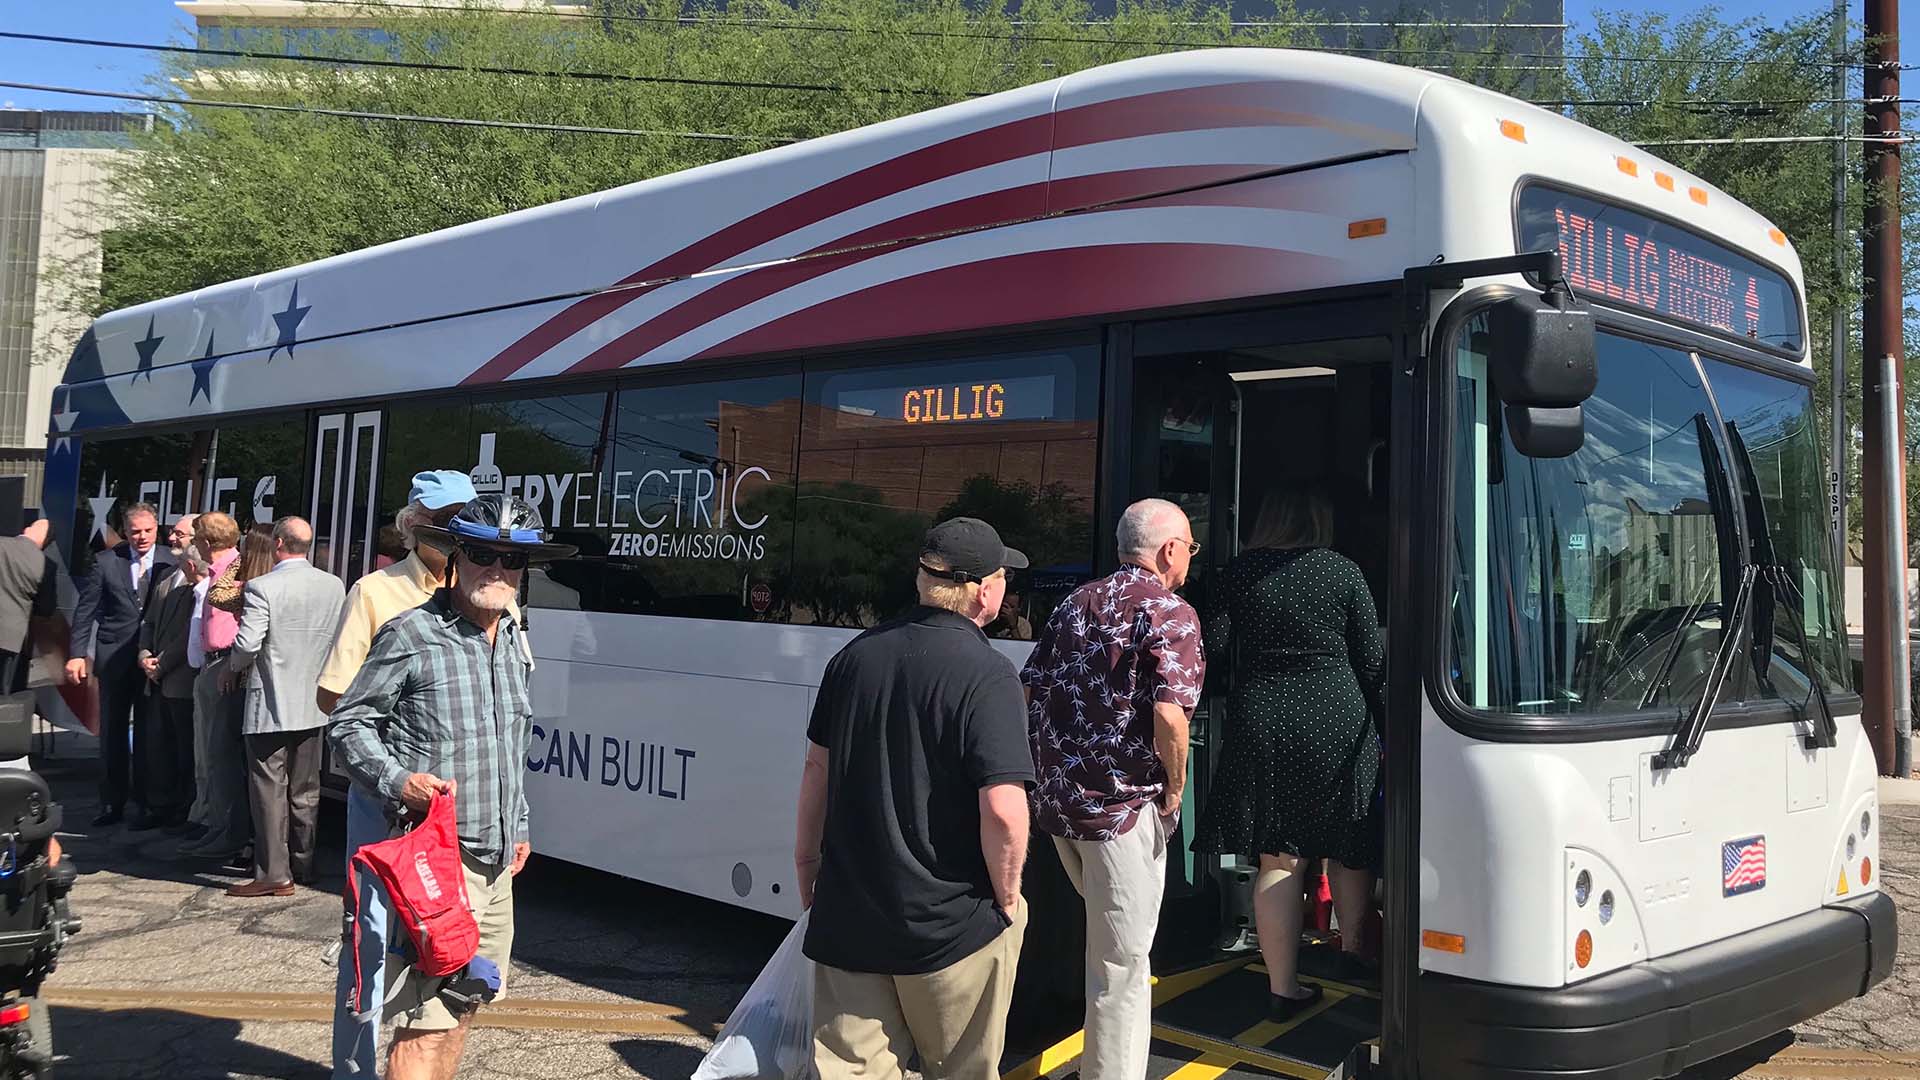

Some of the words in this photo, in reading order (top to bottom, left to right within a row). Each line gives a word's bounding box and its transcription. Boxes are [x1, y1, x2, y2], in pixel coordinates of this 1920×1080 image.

[1668, 282, 1736, 328] ELECTRIC
[904, 383, 1004, 423] GILLIG
[471, 472, 498, 485] GILLIG
[1831, 472, 1840, 516] DTSP
[1831, 520, 1838, 530] 1
[601, 736, 696, 800] BUILT
